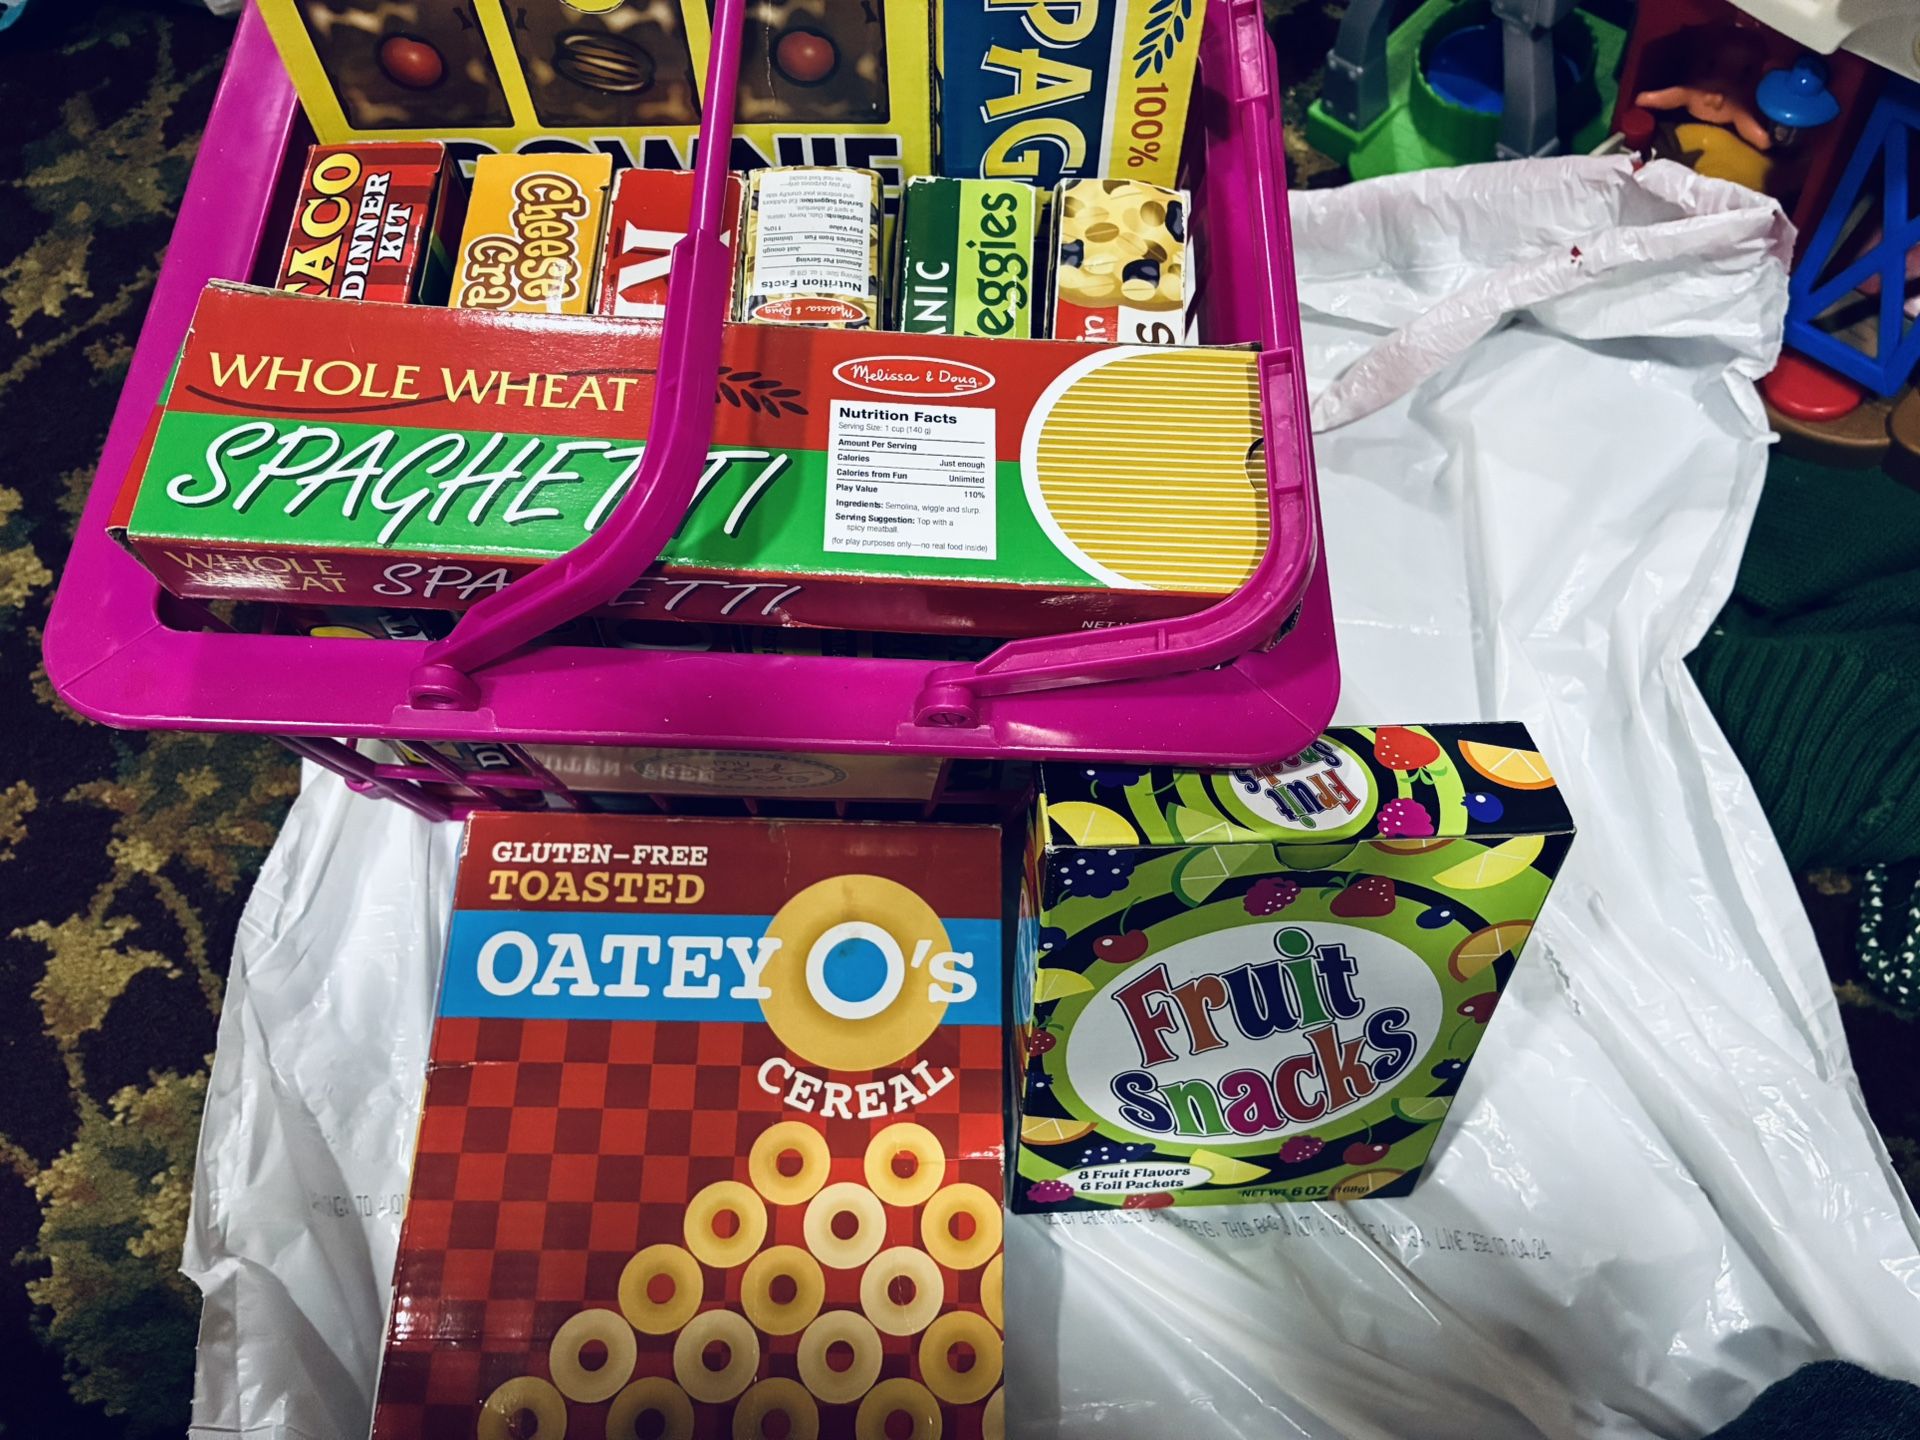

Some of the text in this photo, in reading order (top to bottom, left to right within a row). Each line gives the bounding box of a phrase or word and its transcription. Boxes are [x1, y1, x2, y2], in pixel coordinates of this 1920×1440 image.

[1127, 82, 1168, 167] 100%
[340, 171, 392, 300] DINNER
[377, 204, 413, 262] KIT
[515, 174, 586, 300] Cheese
[837, 236, 862, 244] Calories
[836, 248, 862, 256] Calories
[836, 259, 862, 268] Amount
[964, 192, 1028, 336] eggies
[761, 279, 861, 292] Nutrition Facts
[209, 351, 638, 412] WHOLE WHEAT
[851, 364, 978, 390] Melissa & Doug
[839, 407, 957, 424] Nutrition Facts
[839, 422, 864, 431] Serving
[866, 423, 883, 431] Size:
[838, 438, 869, 447] Amount
[887, 442, 917, 451] Serving
[837, 454, 870, 462] Calories
[958, 461, 985, 469] enough
[836, 469, 869, 477] Calories
[872, 470, 890, 478] from
[949, 475, 984, 483] Unlimited
[836, 484, 878, 493] Play Value
[836, 499, 884, 509] Ingredients:
[885, 502, 919, 511] Semolina,
[922, 504, 944, 514] wiggle
[962, 506, 980, 515] slurp.
[836, 512, 866, 522] Serving
[868, 515, 915, 525] Suggestion:
[917, 518, 930, 526] Top
[847, 525, 865, 534] spicy
[832, 537, 843, 545] (for
[846, 538, 860, 546] play
[862, 539, 895, 548] purposes
[964, 543, 987, 552] inside)
[164, 551, 342, 576] WHOLE
[1081, 620, 1116, 628] NET
[1264, 768, 1360, 828] Fruit
[492, 841, 708, 866] GLUTEN-FREE
[488, 870, 706, 904] TOASTED
[476, 930, 783, 1001] OATEY
[1112, 926, 1365, 1068] Fruit
[756, 1056, 956, 1120] CEREAL
[1078, 1168, 1190, 1180] 8 Fruit Flavors
[1080, 1180, 1184, 1191] 6 Foil Packets
[1292, 1187, 1300, 1196] 6
[1305, 1186, 1328, 1196] OZ
